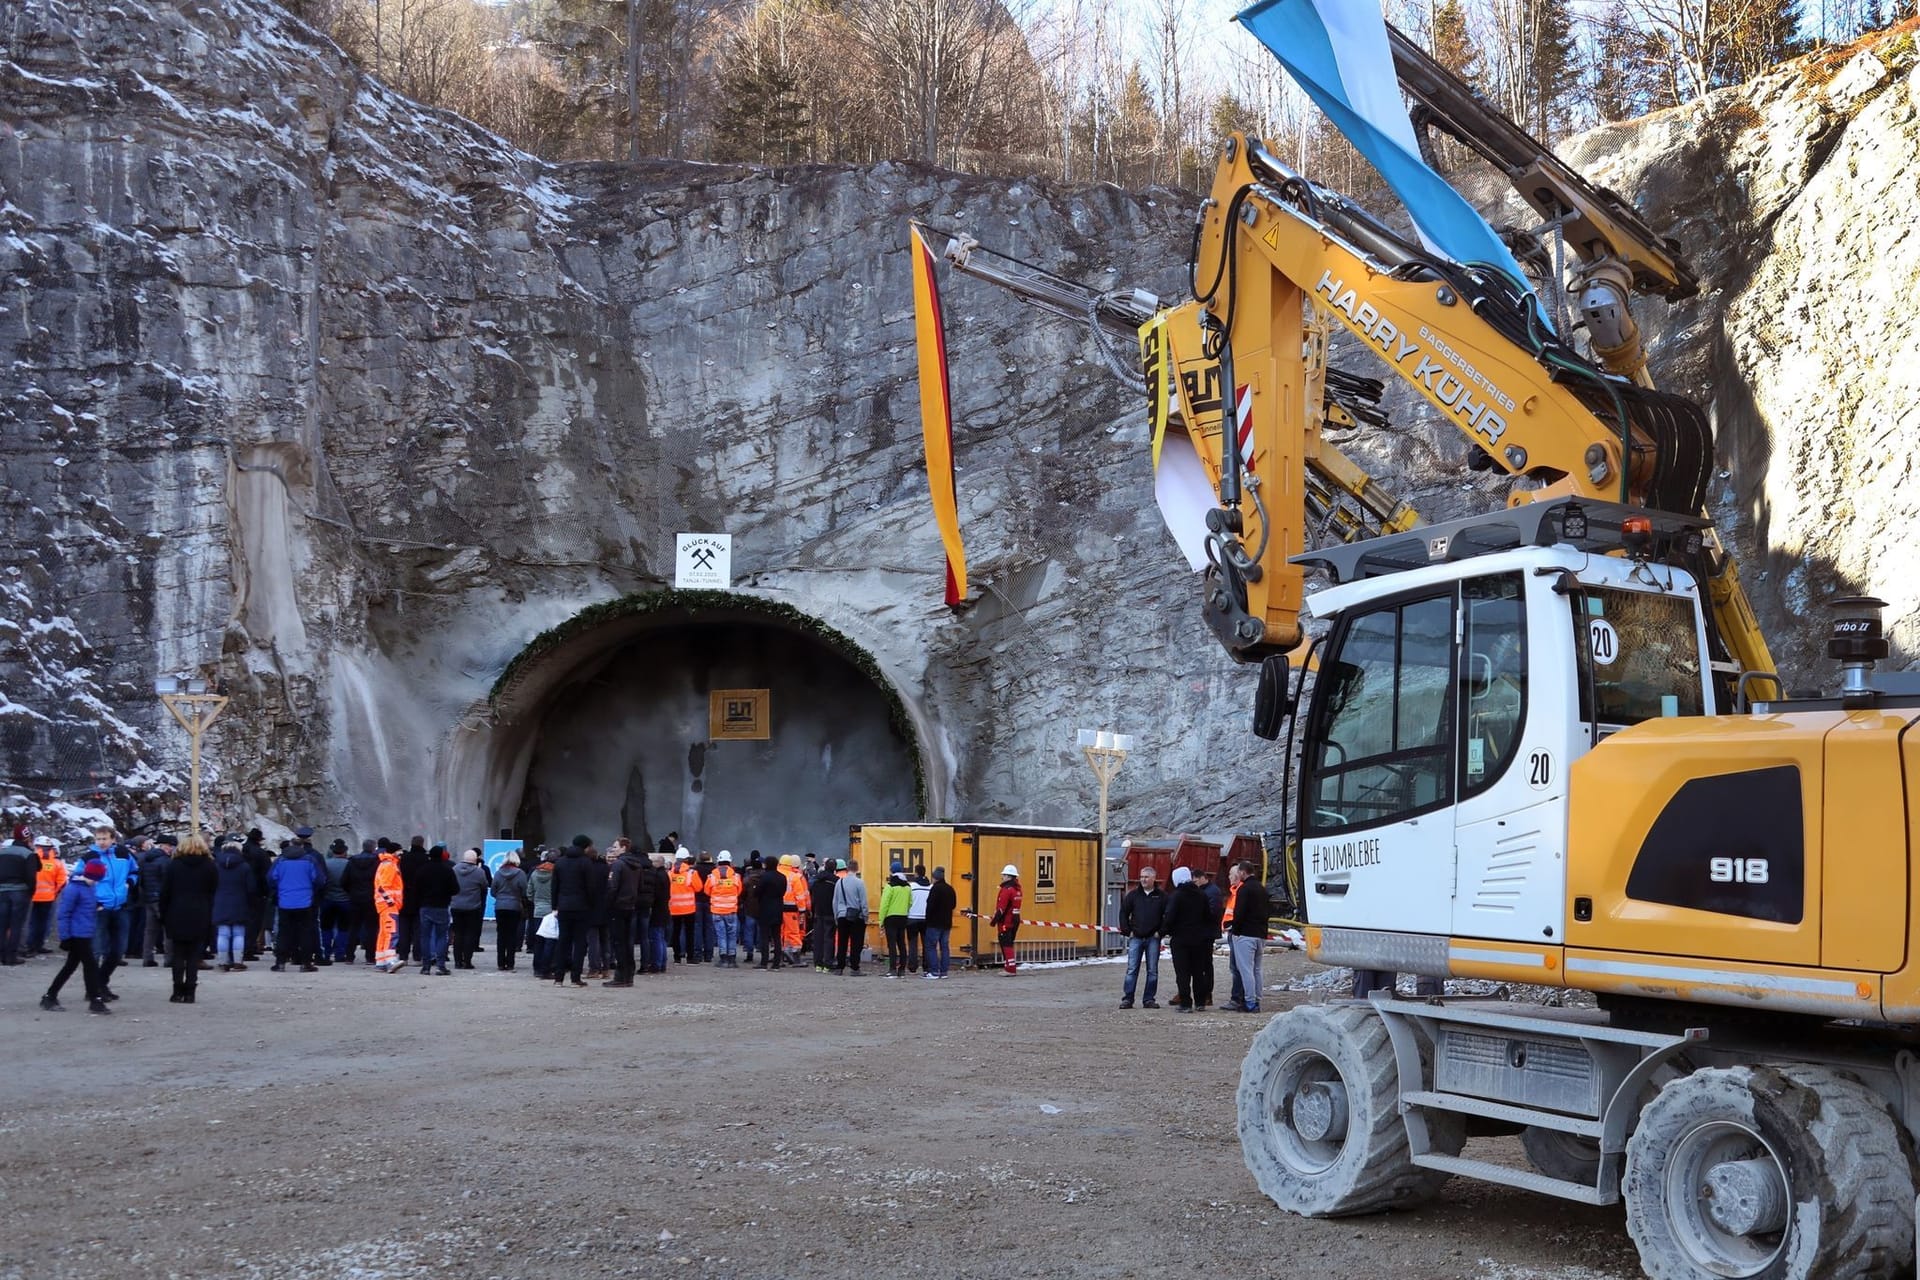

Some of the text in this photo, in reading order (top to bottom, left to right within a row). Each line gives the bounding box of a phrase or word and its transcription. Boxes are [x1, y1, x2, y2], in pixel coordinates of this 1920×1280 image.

[1315, 269, 1507, 448] HARRY KÜHR
[1418, 325, 1516, 413] BAGGERBETRIEB
[711, 541, 727, 553] AUF
[1592, 626, 1612, 658] 20
[1530, 753, 1550, 785] 20
[1710, 857, 1769, 884] 918
